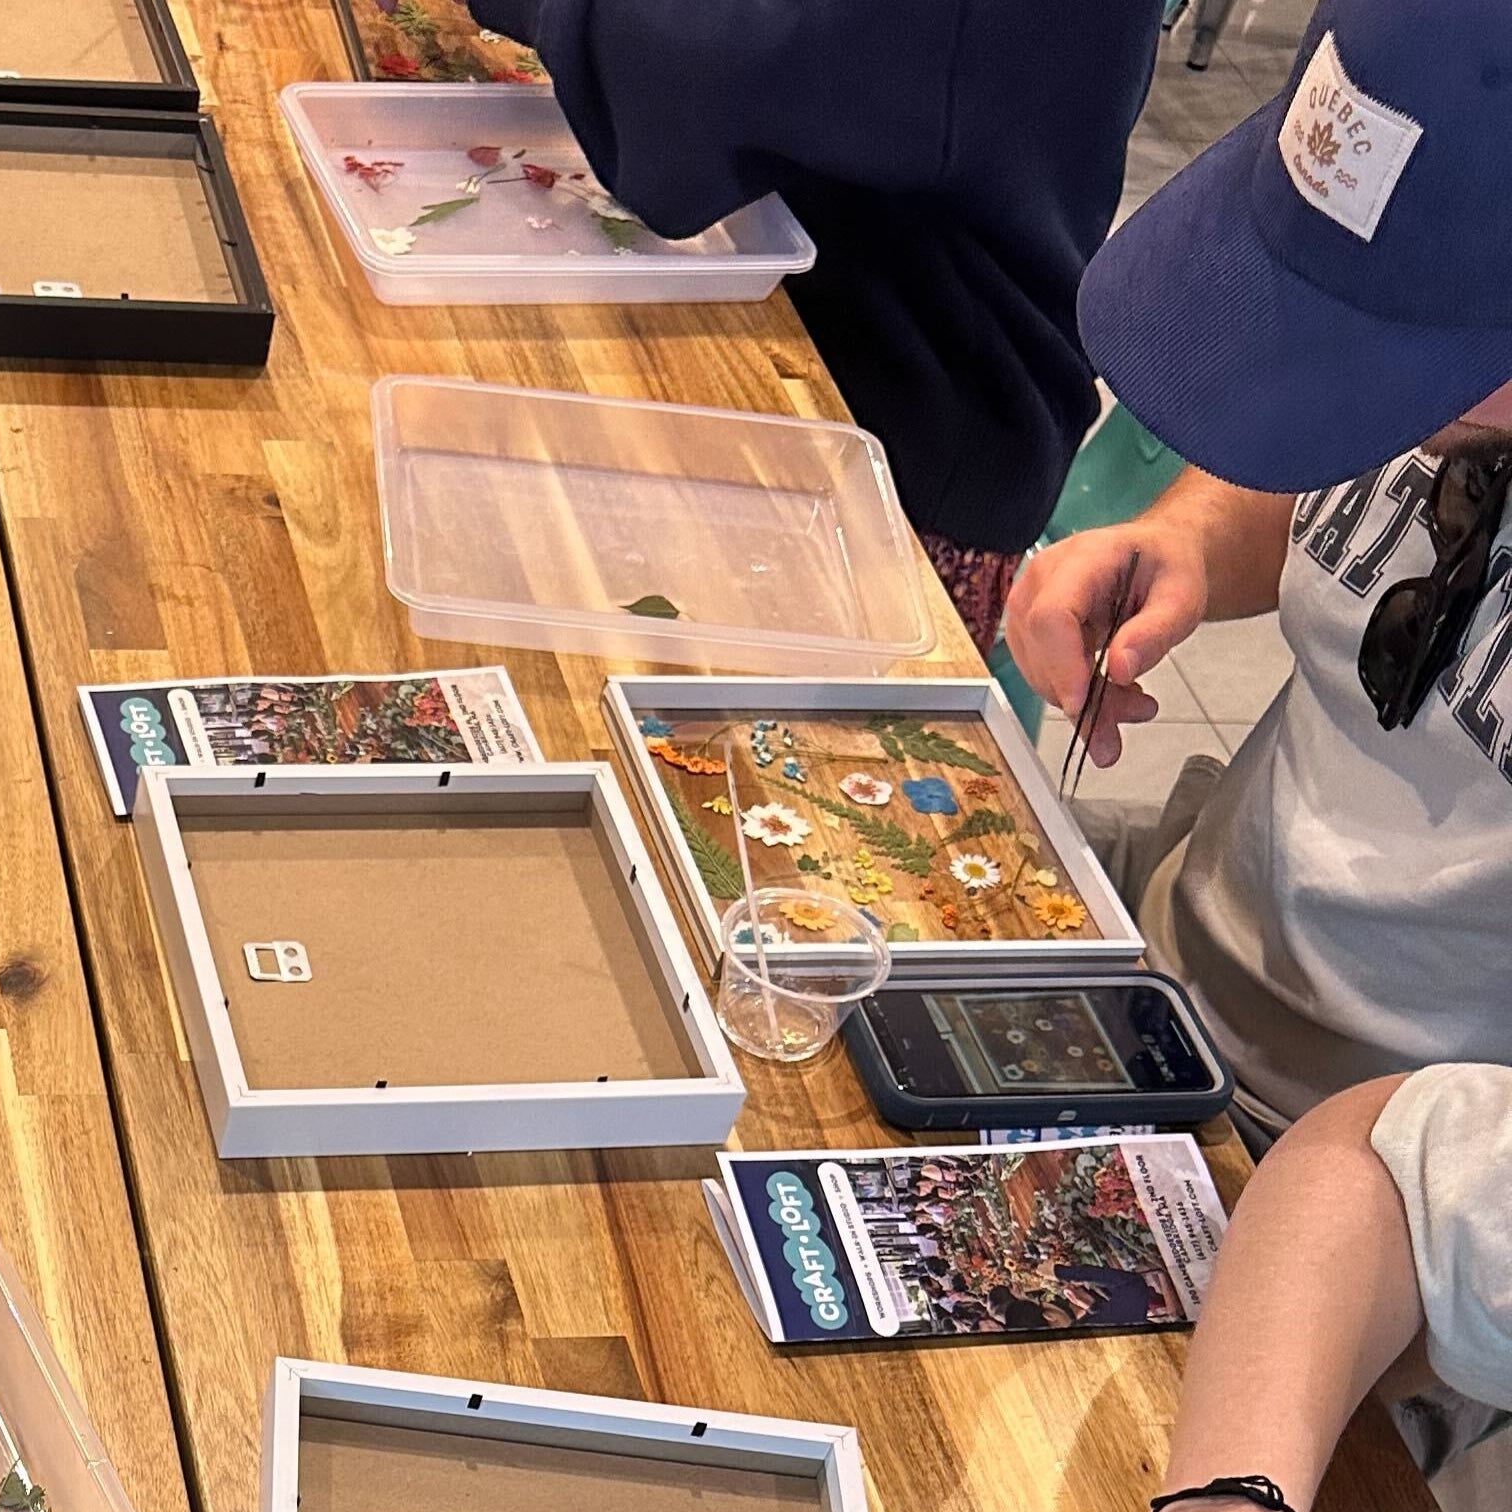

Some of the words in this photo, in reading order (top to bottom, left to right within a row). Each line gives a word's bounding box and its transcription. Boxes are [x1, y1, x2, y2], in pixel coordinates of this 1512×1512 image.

[129, 705, 157, 738] LOFT
[1136, 1155, 1152, 1185] FLOOR
[776, 1182, 811, 1232] LOFT
[798, 1246, 840, 1322] CRAFT
